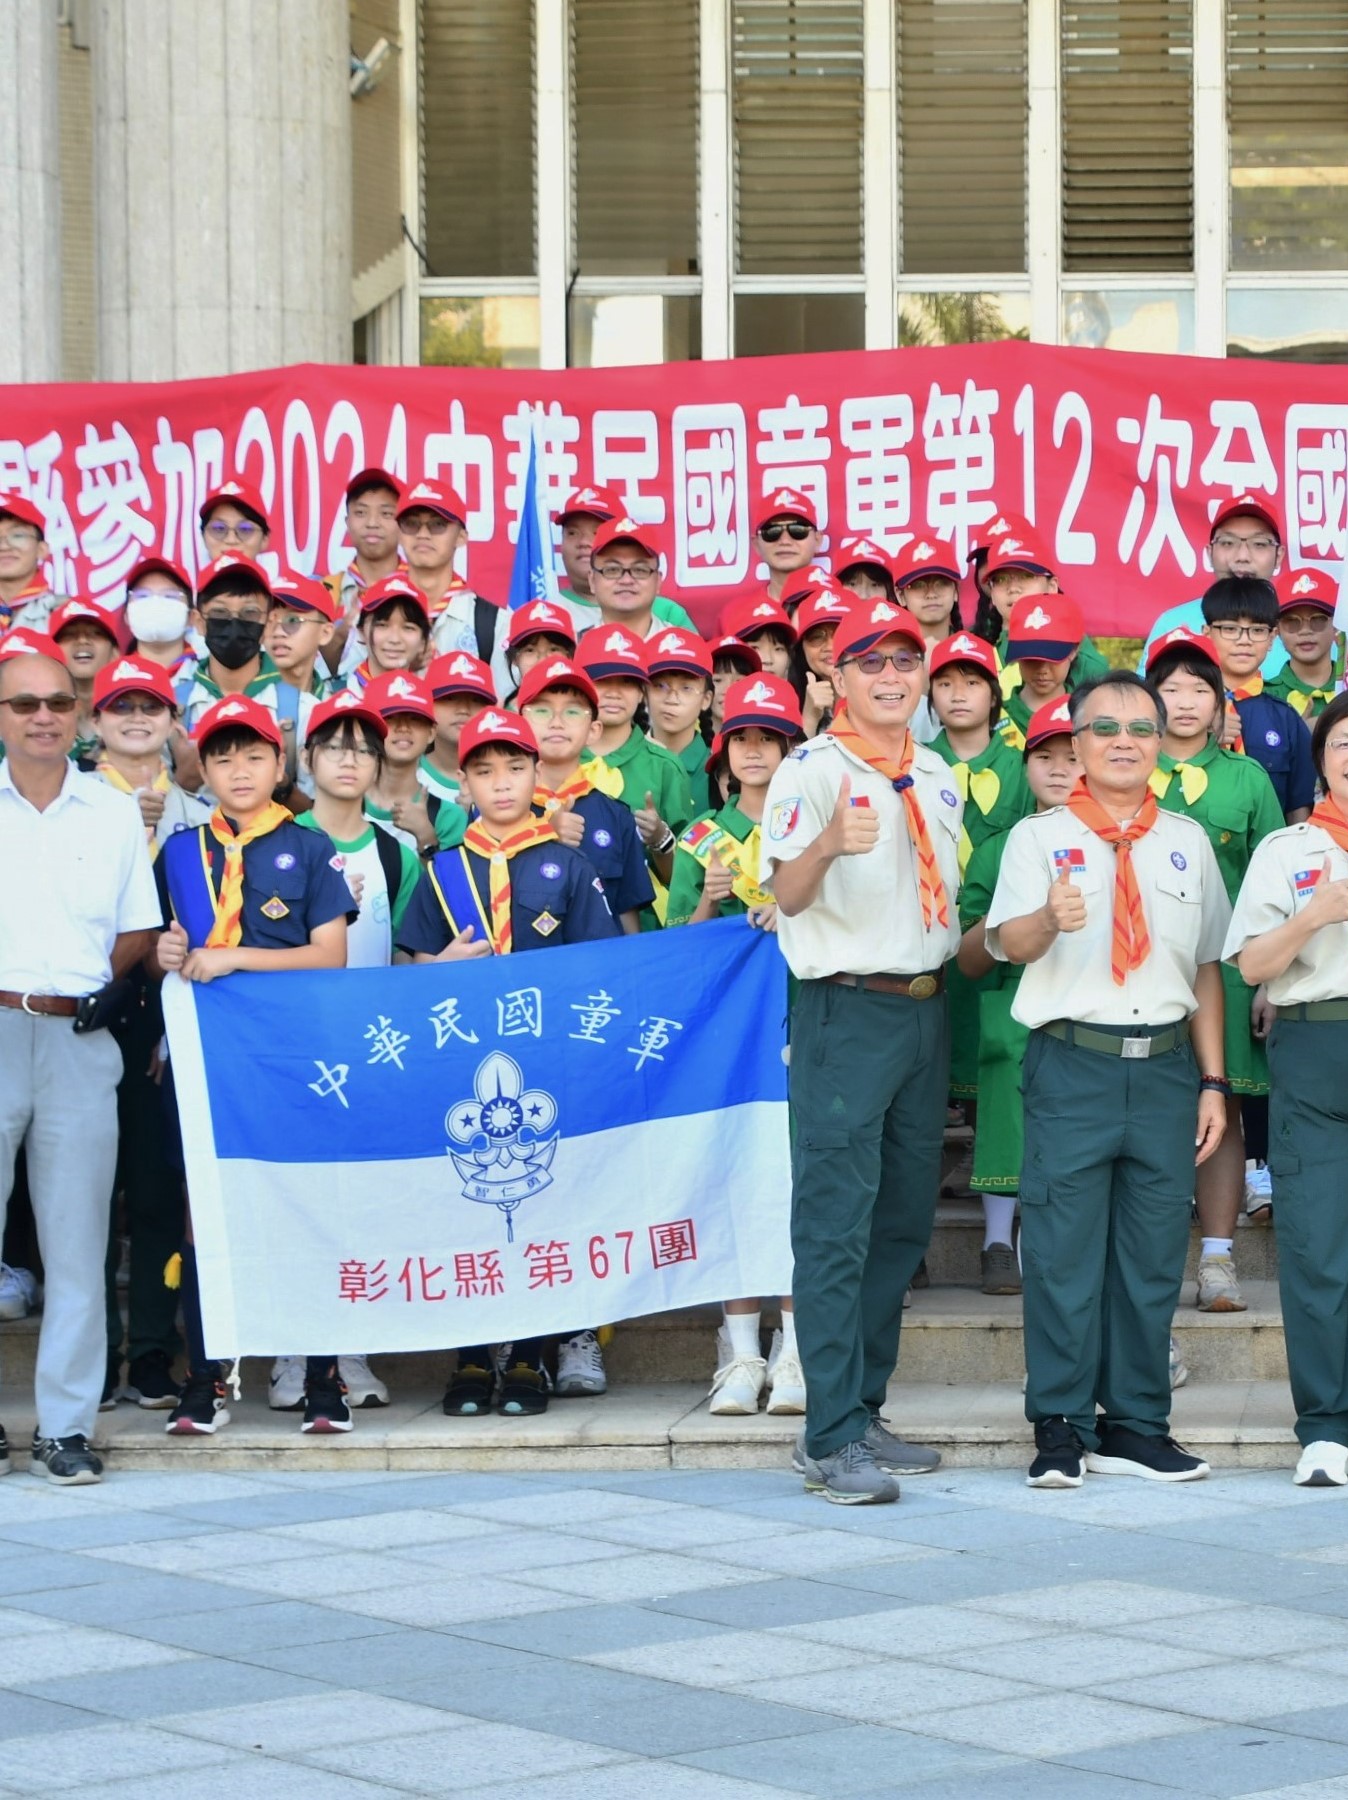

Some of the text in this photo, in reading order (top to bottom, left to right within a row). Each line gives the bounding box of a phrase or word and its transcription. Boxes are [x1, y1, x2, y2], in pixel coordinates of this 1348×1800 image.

[307, 986, 683, 1109] 中華民國童軍
